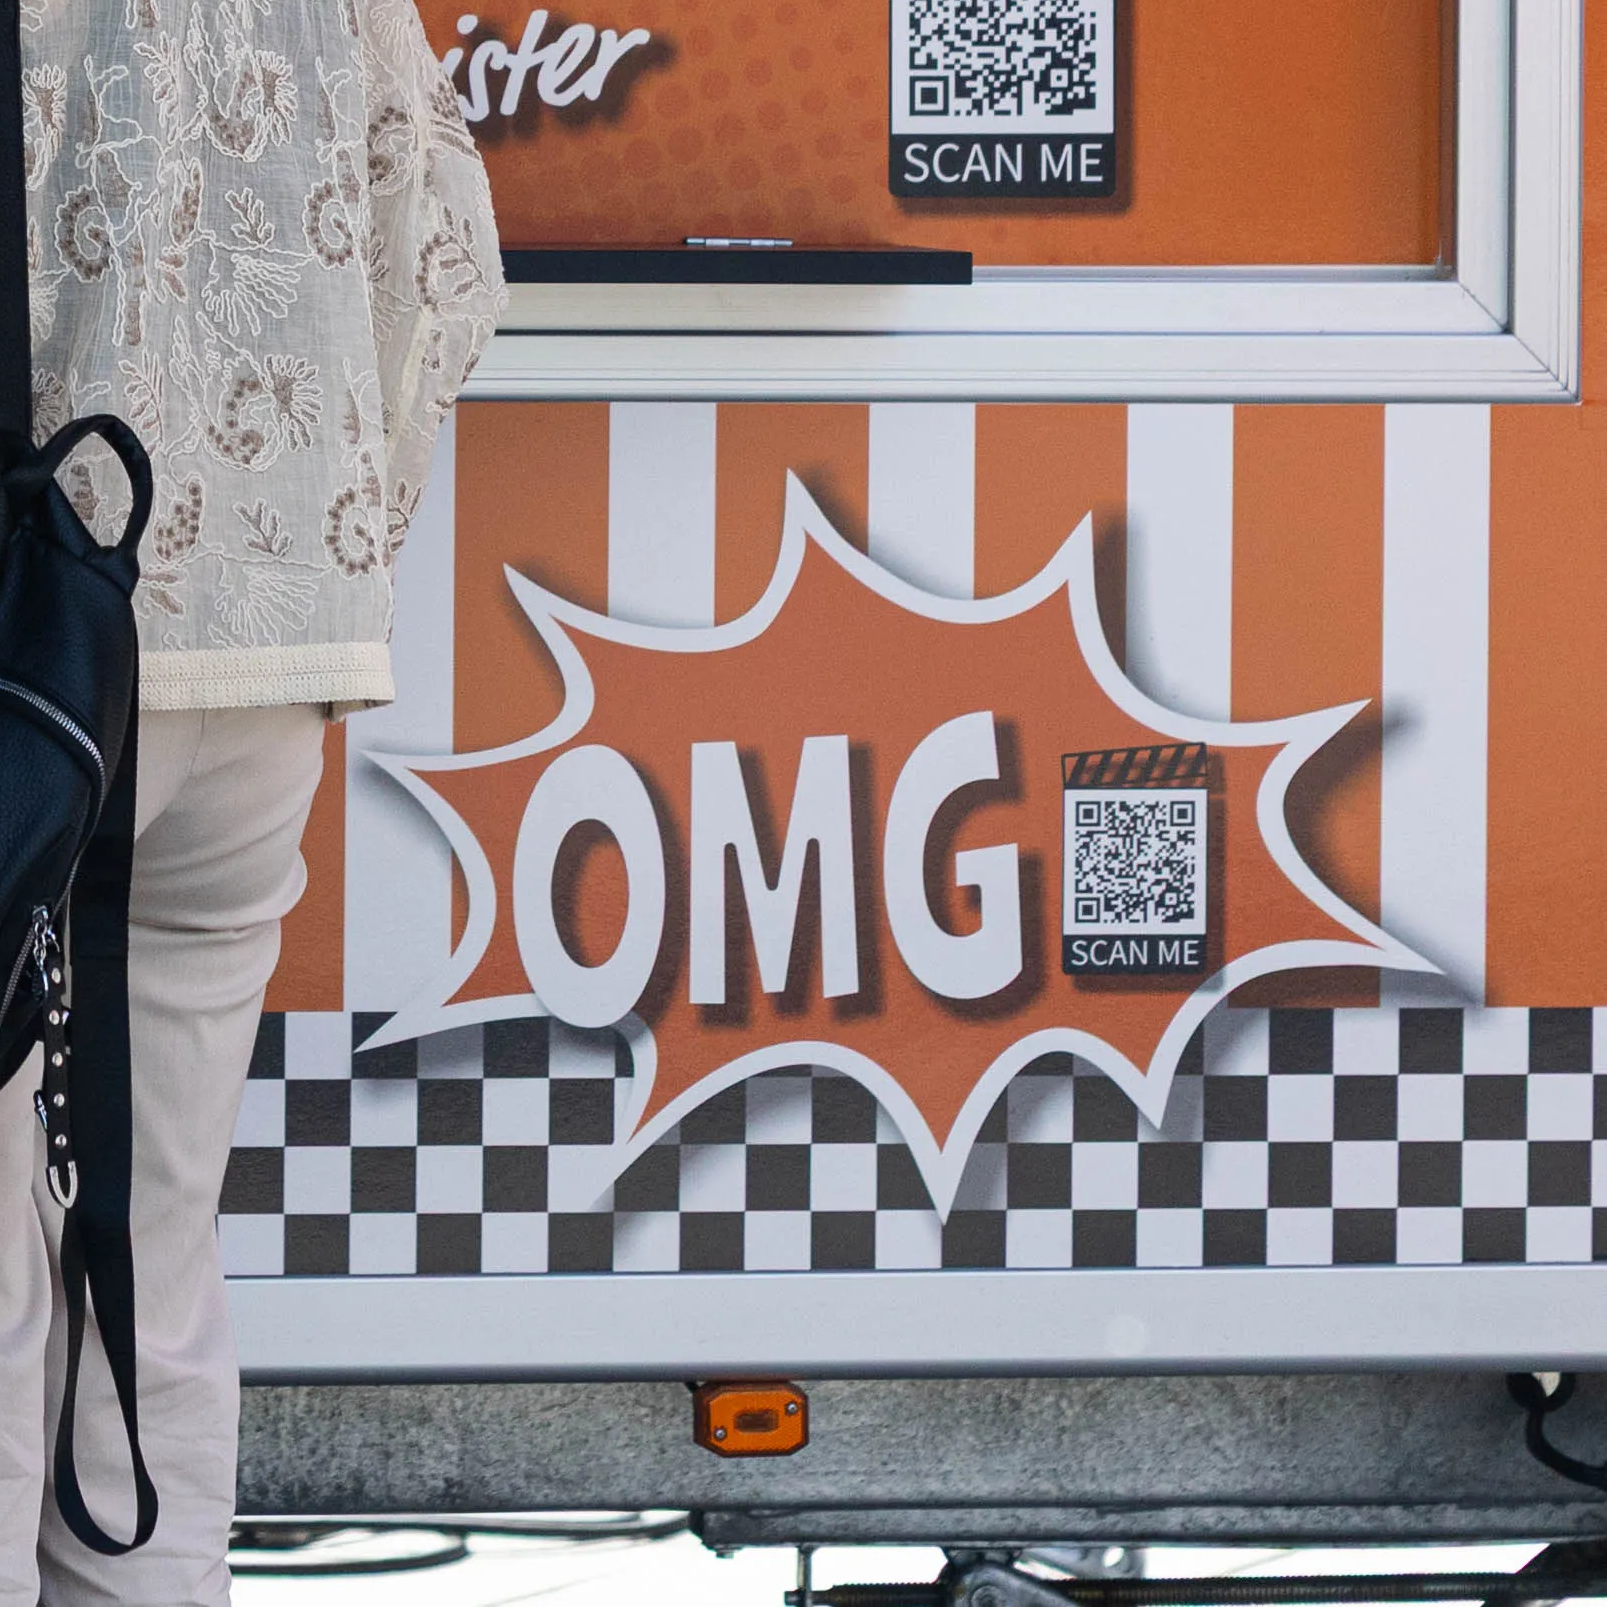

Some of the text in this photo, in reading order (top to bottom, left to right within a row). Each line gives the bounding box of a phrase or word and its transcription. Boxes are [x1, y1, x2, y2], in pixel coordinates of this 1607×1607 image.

[902, 142, 1104, 183] SCAN ME
[512, 710, 1024, 1029] OMG
[1070, 939, 1200, 966] SCAN ME
